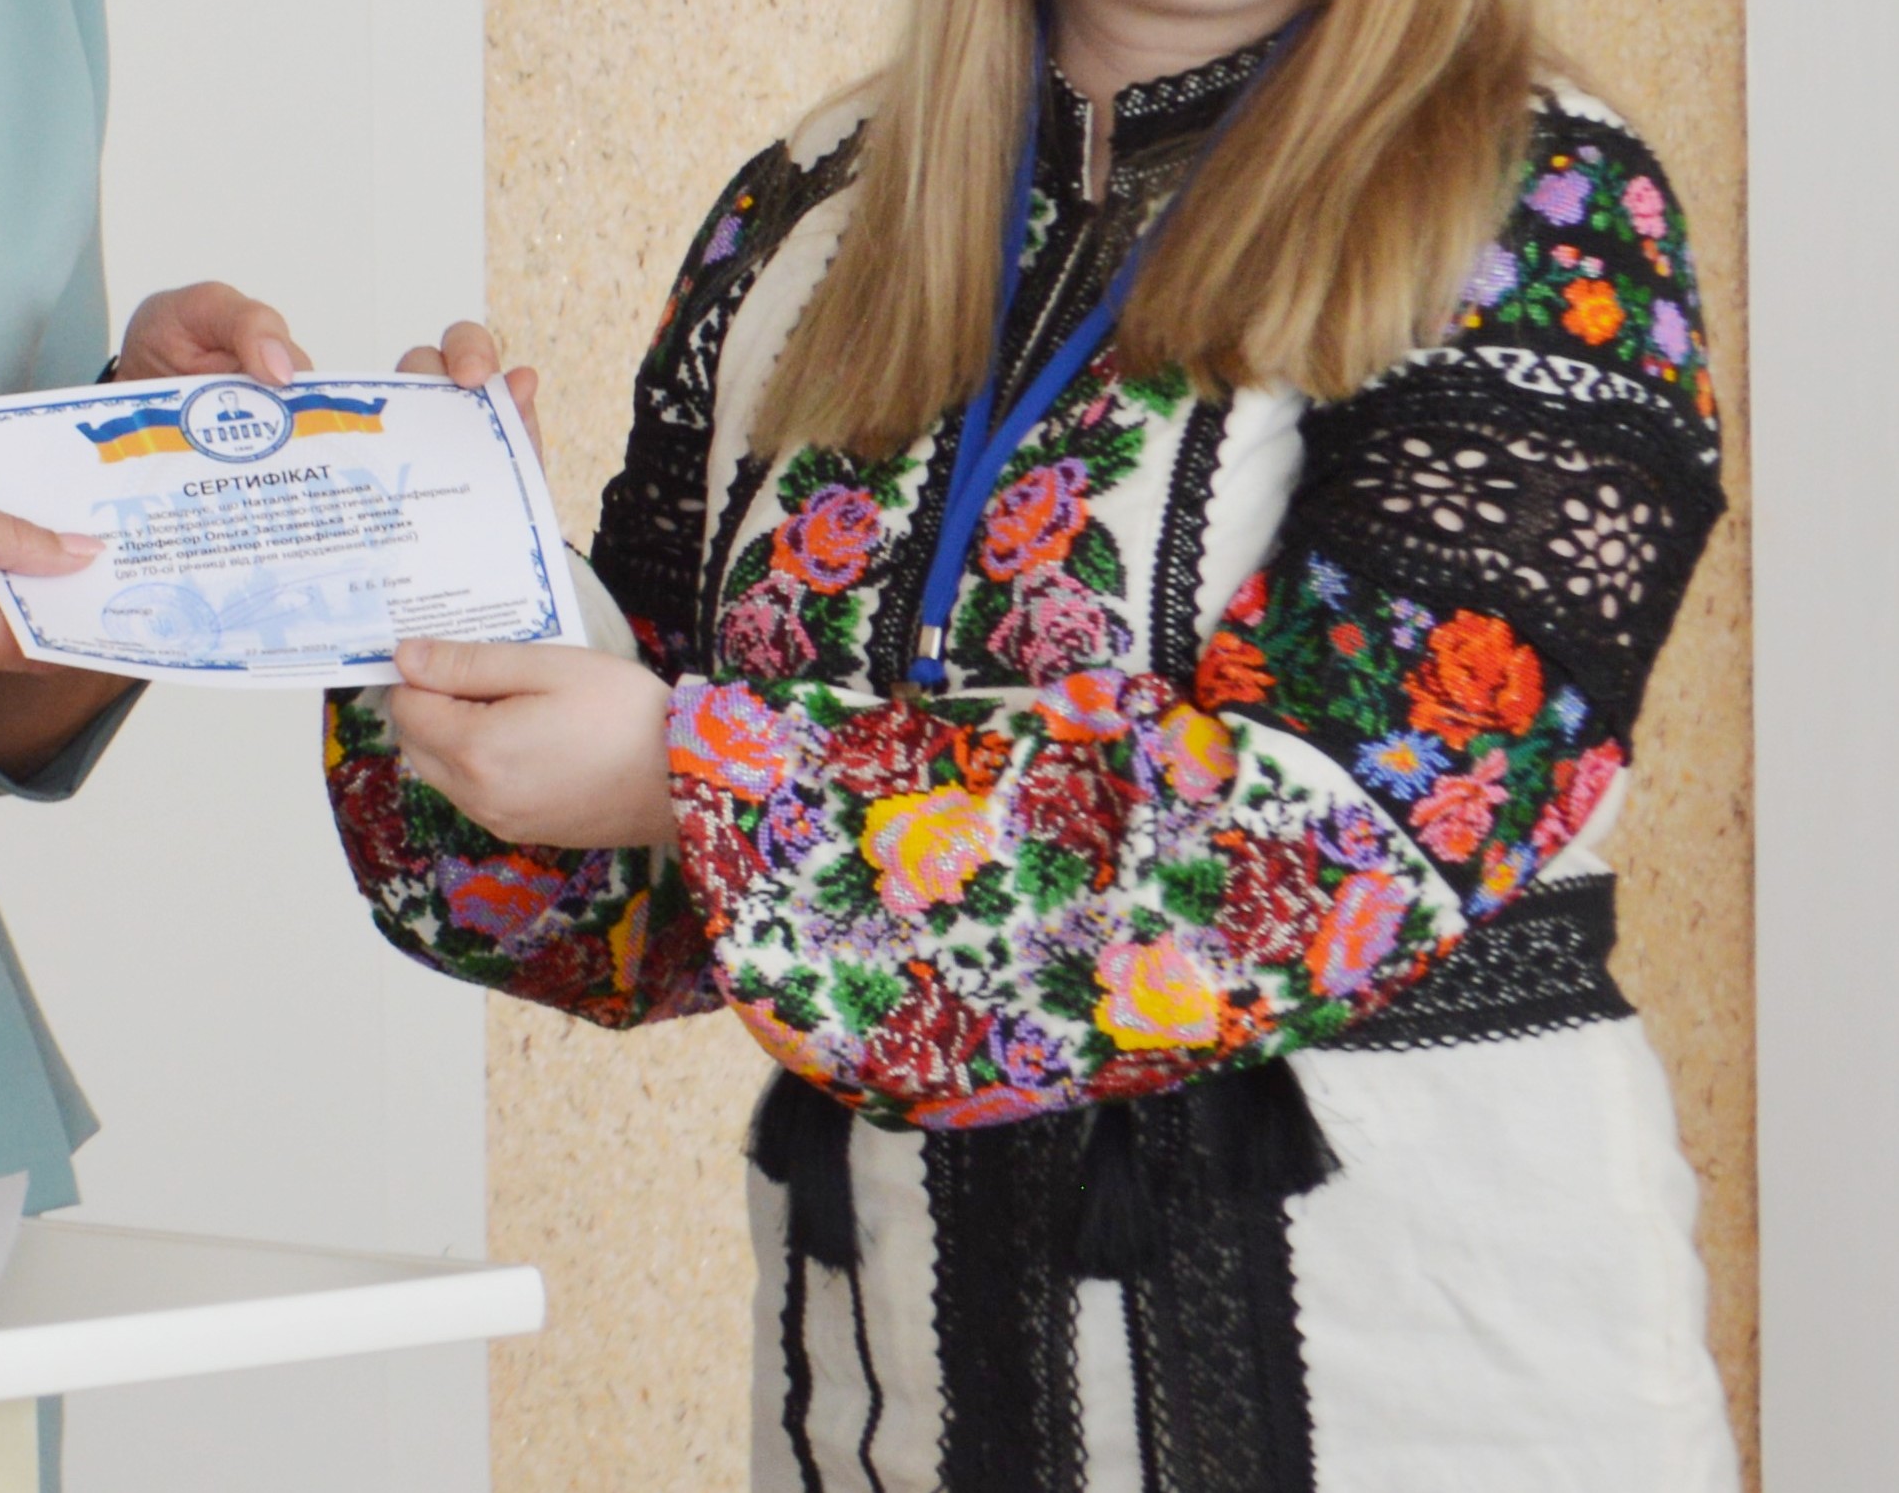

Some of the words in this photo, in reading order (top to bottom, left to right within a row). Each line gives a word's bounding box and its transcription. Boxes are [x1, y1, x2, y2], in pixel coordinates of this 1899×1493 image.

[183, 464, 331, 498] СЕРТИФІКАТ
[219, 501, 239, 513] що
[242, 493, 298, 507] Наталія
[302, 483, 371, 499] Чеканова
[176, 540, 262, 559] організатор
[266, 526, 360, 548] географічної
[205, 528, 249, 542] Ольга
[254, 516, 344, 537] Заставецька
